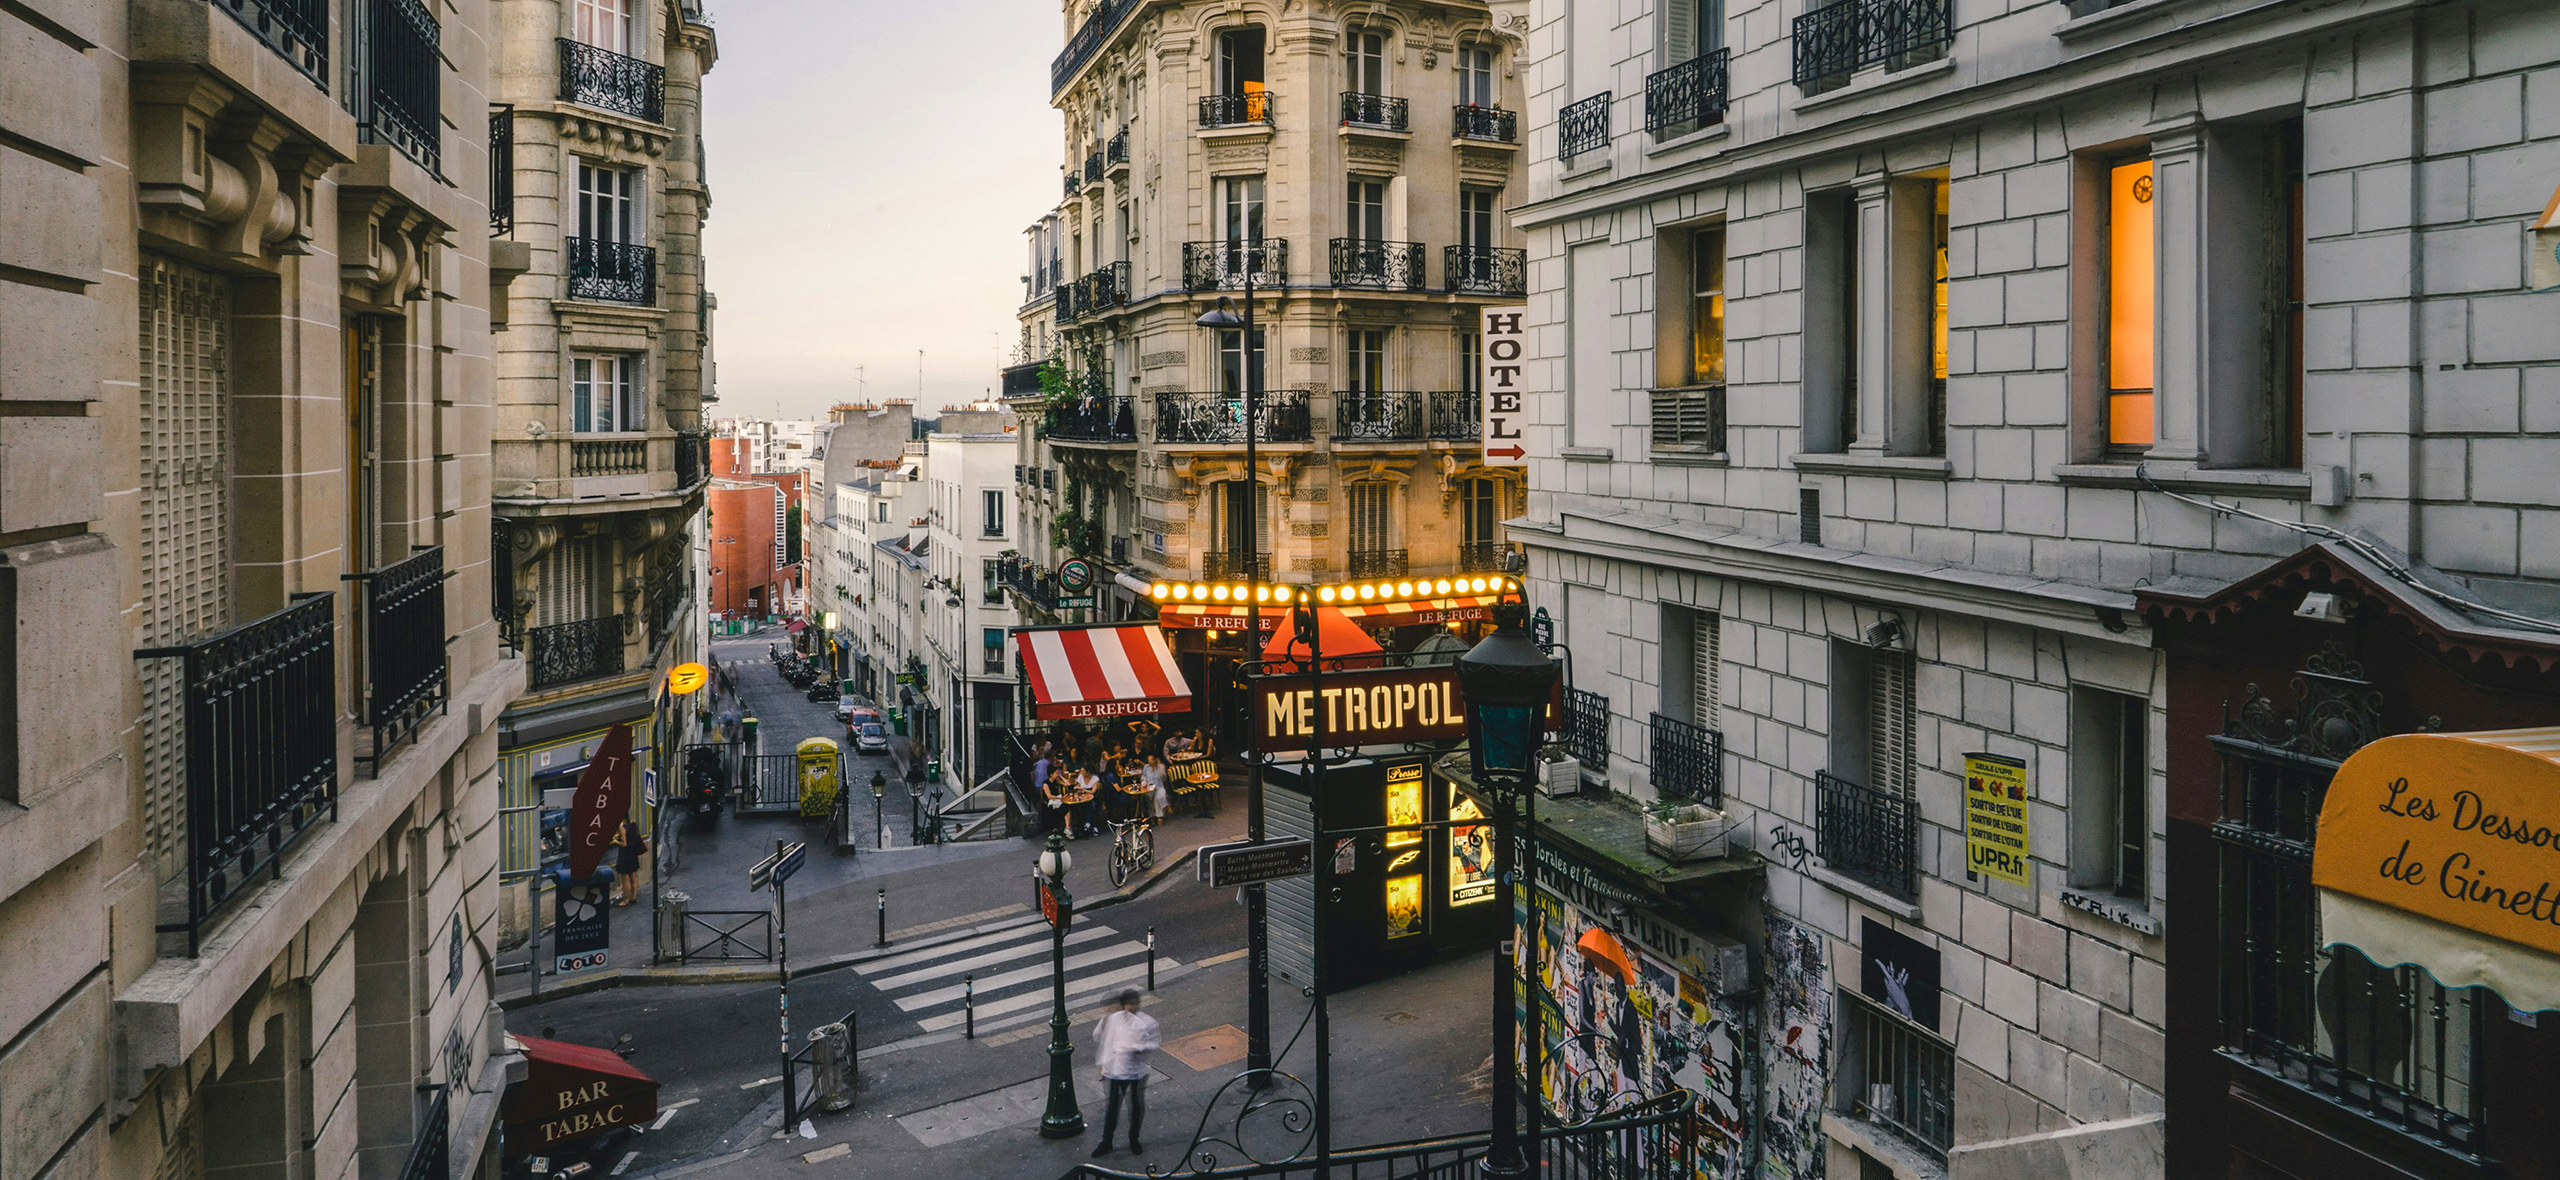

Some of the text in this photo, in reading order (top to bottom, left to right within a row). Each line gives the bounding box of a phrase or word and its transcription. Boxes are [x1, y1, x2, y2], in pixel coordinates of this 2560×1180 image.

[1487, 313, 1522, 439] HOTEL
[1068, 598, 1093, 607] REFUGE
[1193, 617, 1271, 630] LE REFUE
[1418, 612, 1434, 624] LE
[1071, 701, 1159, 717] LE REFUGE
[1267, 681, 1550, 737] METROPOL
[1389, 768, 1420, 780] Presse
[1975, 762, 1995, 773] SEULE
[585, 756, 620, 847] TABAC
[1970, 797, 2023, 820] SORTIR DE L'UE
[2378, 777, 2441, 822] Les
[1970, 813, 2023, 835] SORTIR DE L'EURO
[1970, 827, 2024, 849] SORTIR DE L'OTAN
[1247, 850, 1287, 862] Montmartre
[1251, 858, 1290, 869] Montmartre
[1533, 840, 1568, 876] lorales
[1570, 865, 1580, 882] et
[2379, 839, 2426, 886] de
[559, 953, 606, 970] LOTO
[557, 1080, 610, 1111] BAR
[540, 1103, 625, 1142] TABAC
